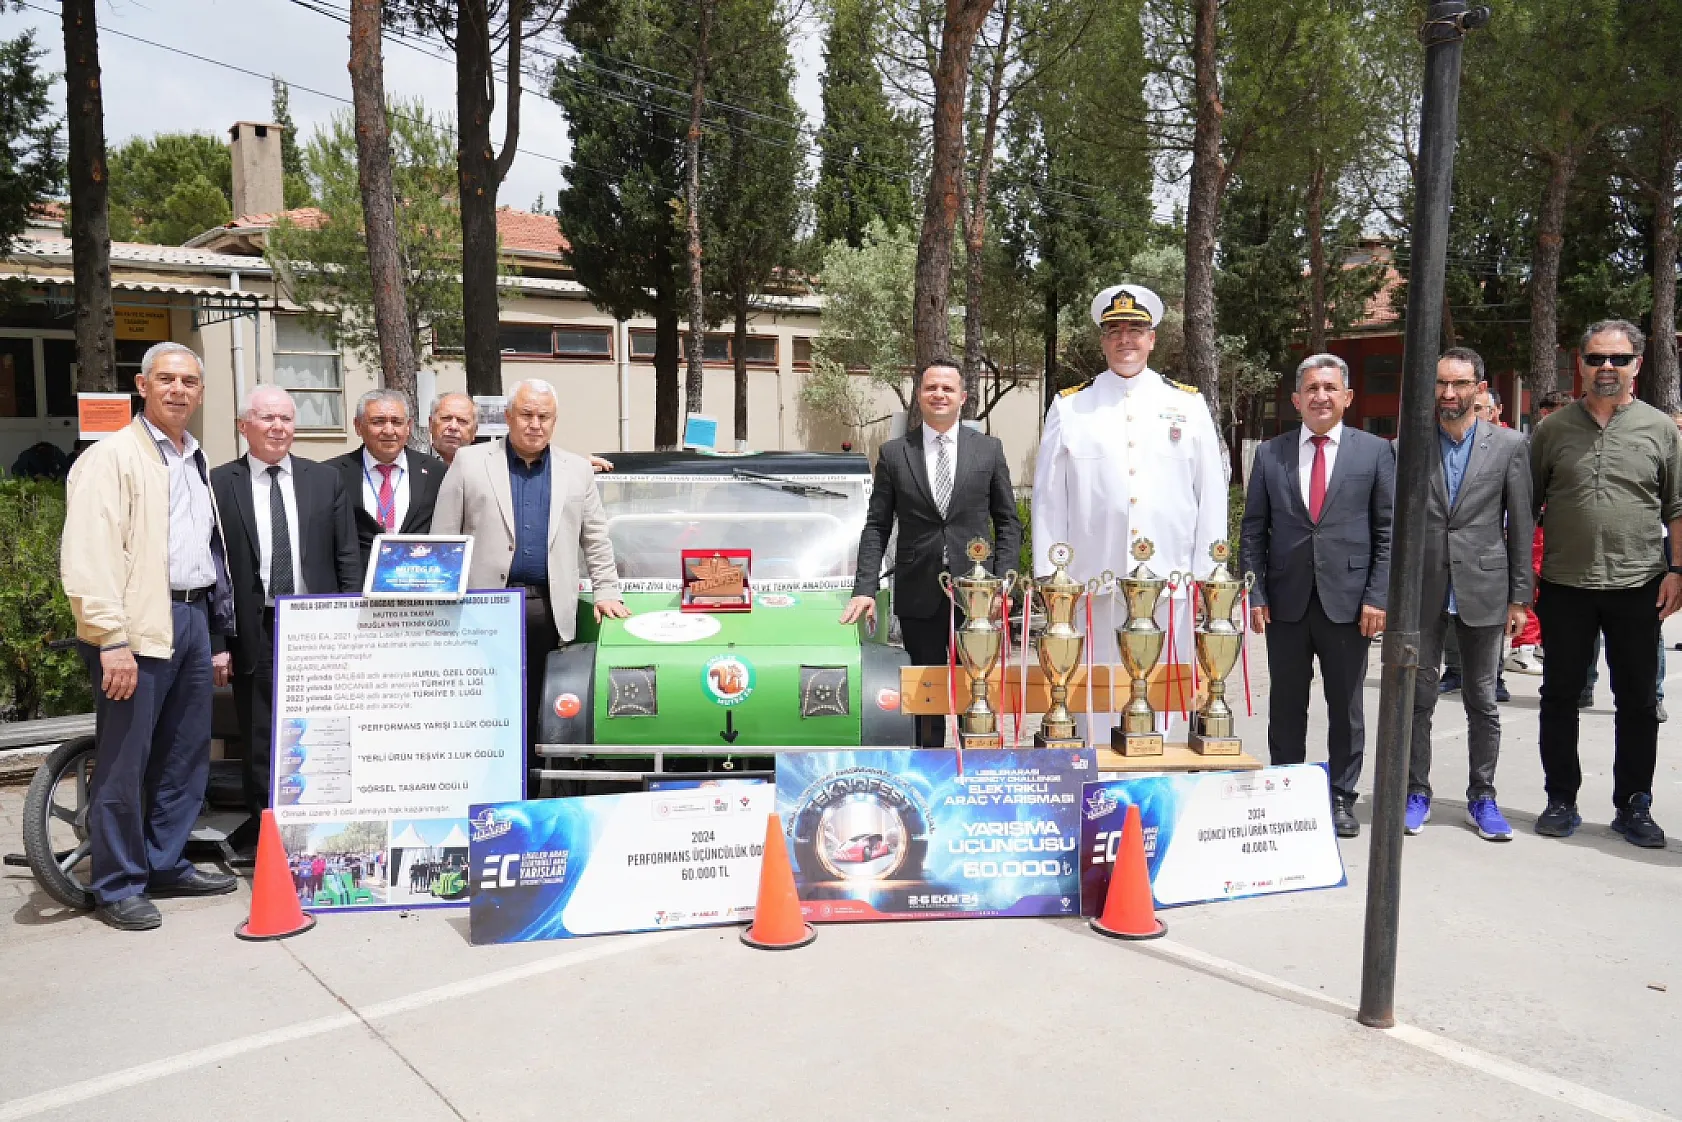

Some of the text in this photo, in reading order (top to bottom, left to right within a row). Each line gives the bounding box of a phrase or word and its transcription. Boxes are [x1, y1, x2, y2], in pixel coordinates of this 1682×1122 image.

[691, 829, 716, 844] 2024
[627, 848, 691, 867] PERFORMANS
[691, 843, 748, 863] ÜÇÜNCÜLÜK
[681, 864, 731, 881] 60.000 TL
[963, 859, 1061, 878] 60.000
